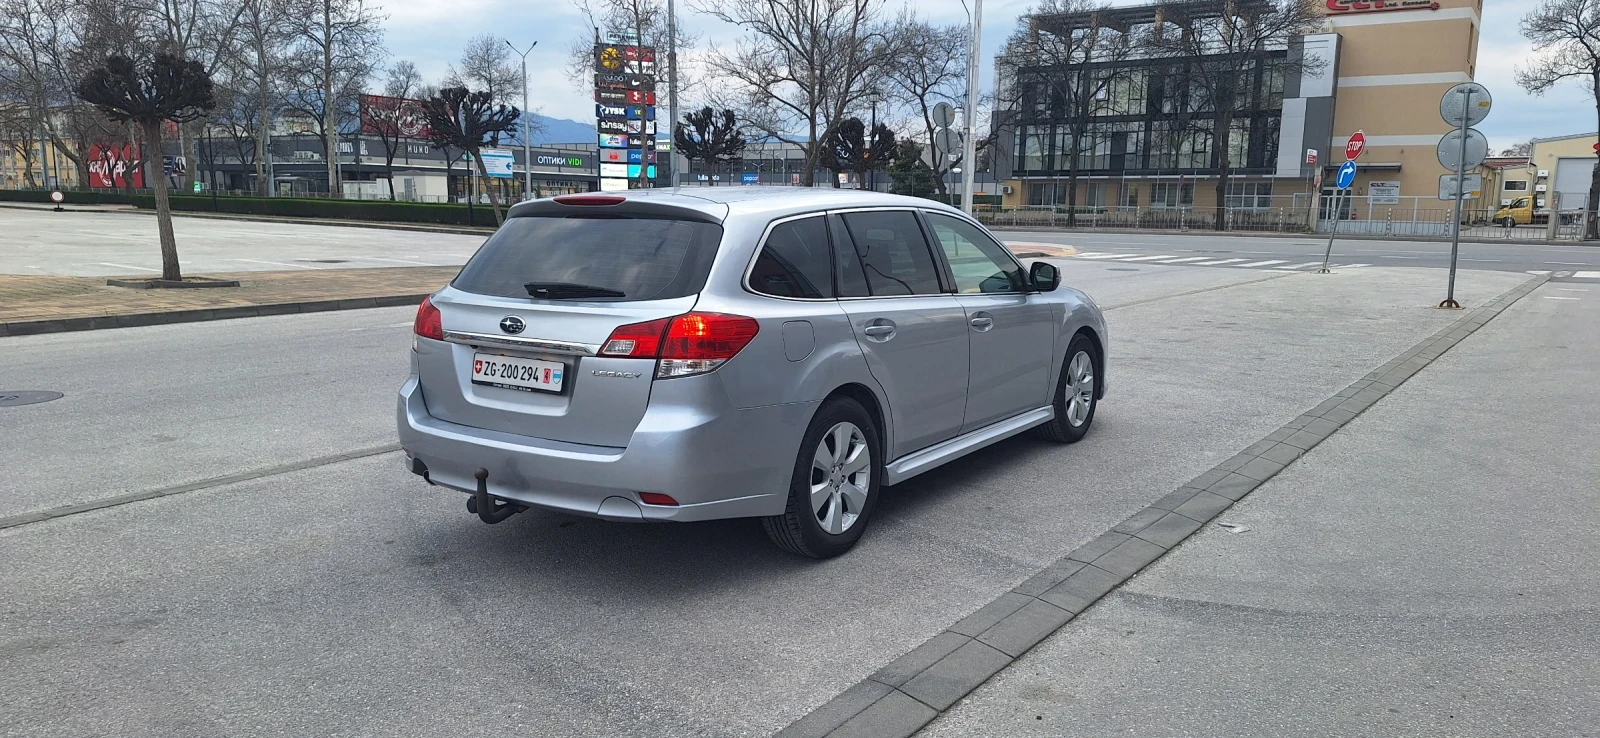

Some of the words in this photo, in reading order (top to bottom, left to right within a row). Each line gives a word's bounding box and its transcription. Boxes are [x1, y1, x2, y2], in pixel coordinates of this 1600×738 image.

[605, 107, 625, 115] JYSK
[601, 120, 627, 131] sinsay
[1347, 141, 1363, 151] STOP
[568, 157, 582, 166] VIDI
[591, 370, 642, 378] LEGACY
